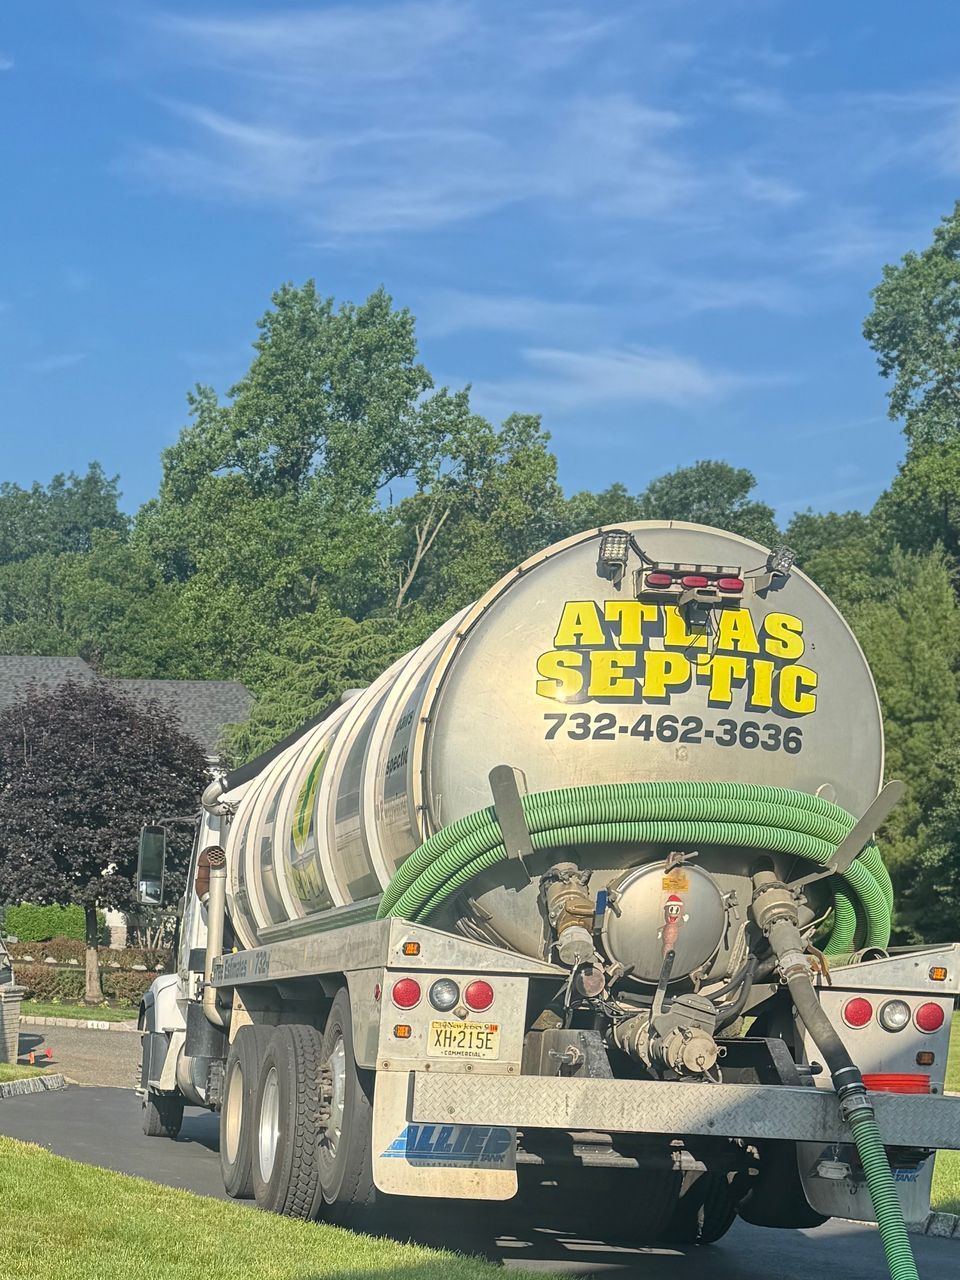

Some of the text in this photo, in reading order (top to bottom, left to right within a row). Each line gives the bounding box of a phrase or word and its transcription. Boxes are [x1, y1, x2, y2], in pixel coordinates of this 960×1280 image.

[553, 600, 805, 662] ATLAS
[536, 650, 818, 717] SEPTIC
[544, 713, 803, 754] 732-462-3636
[386, 1125, 512, 1154] ALLIED
[480, 1153, 506, 1163] TANK
